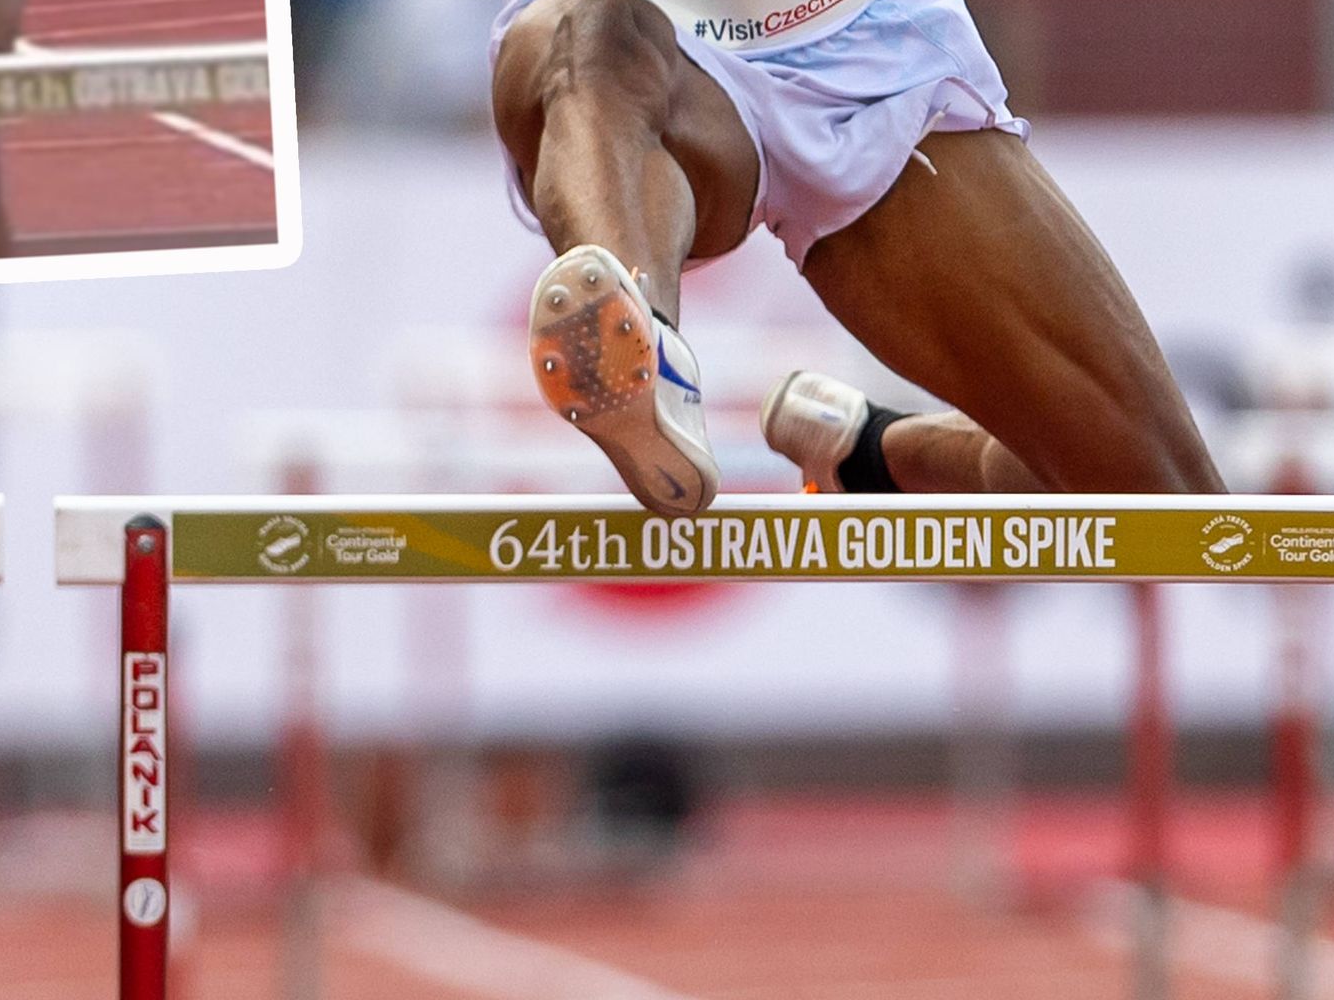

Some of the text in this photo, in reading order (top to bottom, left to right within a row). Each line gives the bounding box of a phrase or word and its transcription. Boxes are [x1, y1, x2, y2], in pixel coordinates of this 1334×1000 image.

[326, 534, 408, 549] Continental
[488, 516, 1116, 572] 64th OSTRAVA GOLDEN SPIKE
[335, 549, 400, 563] Tour Gold
[1277, 549, 1308, 562] Tour
[130, 660, 162, 834] POLANIK
